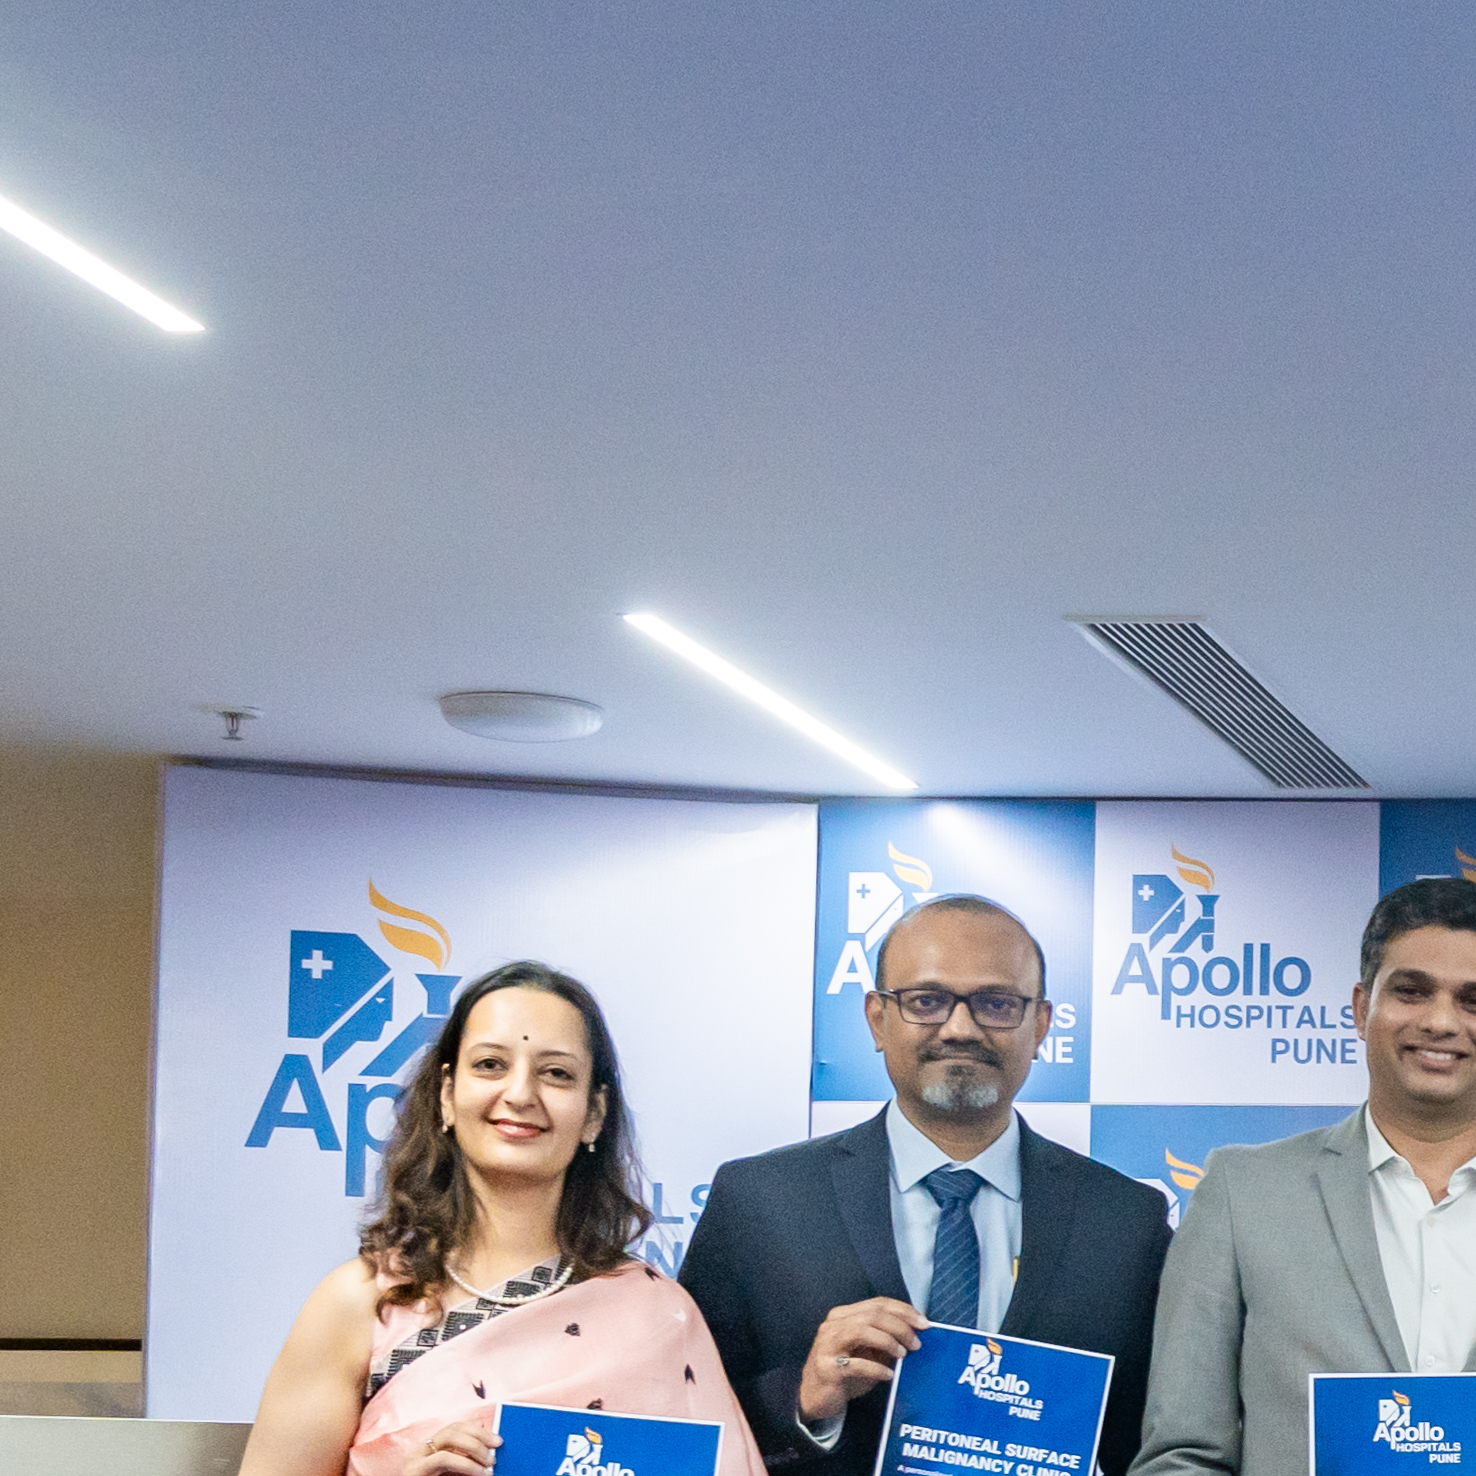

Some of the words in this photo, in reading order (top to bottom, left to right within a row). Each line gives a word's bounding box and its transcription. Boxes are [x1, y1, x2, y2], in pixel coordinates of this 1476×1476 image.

[1111, 943, 1312, 1021] Apollo
[1176, 1005, 1357, 1029] HOSPITALS
[1270, 1039, 1358, 1065] PUNE
[957, 1365, 1030, 1395] Apollo
[978, 1389, 1044, 1409] HOSPITALS
[1008, 1406, 1042, 1421] PUNE
[899, 1423, 1002, 1455] PERITONEAL
[1004, 1443, 1081, 1469] SURFACE
[1373, 1422, 1445, 1450] Apollo
[1396, 1442, 1461, 1452] HOSPITALS
[902, 1443, 1015, 1474] MALIGNANCY
[1429, 1453, 1461, 1463] PUNE
